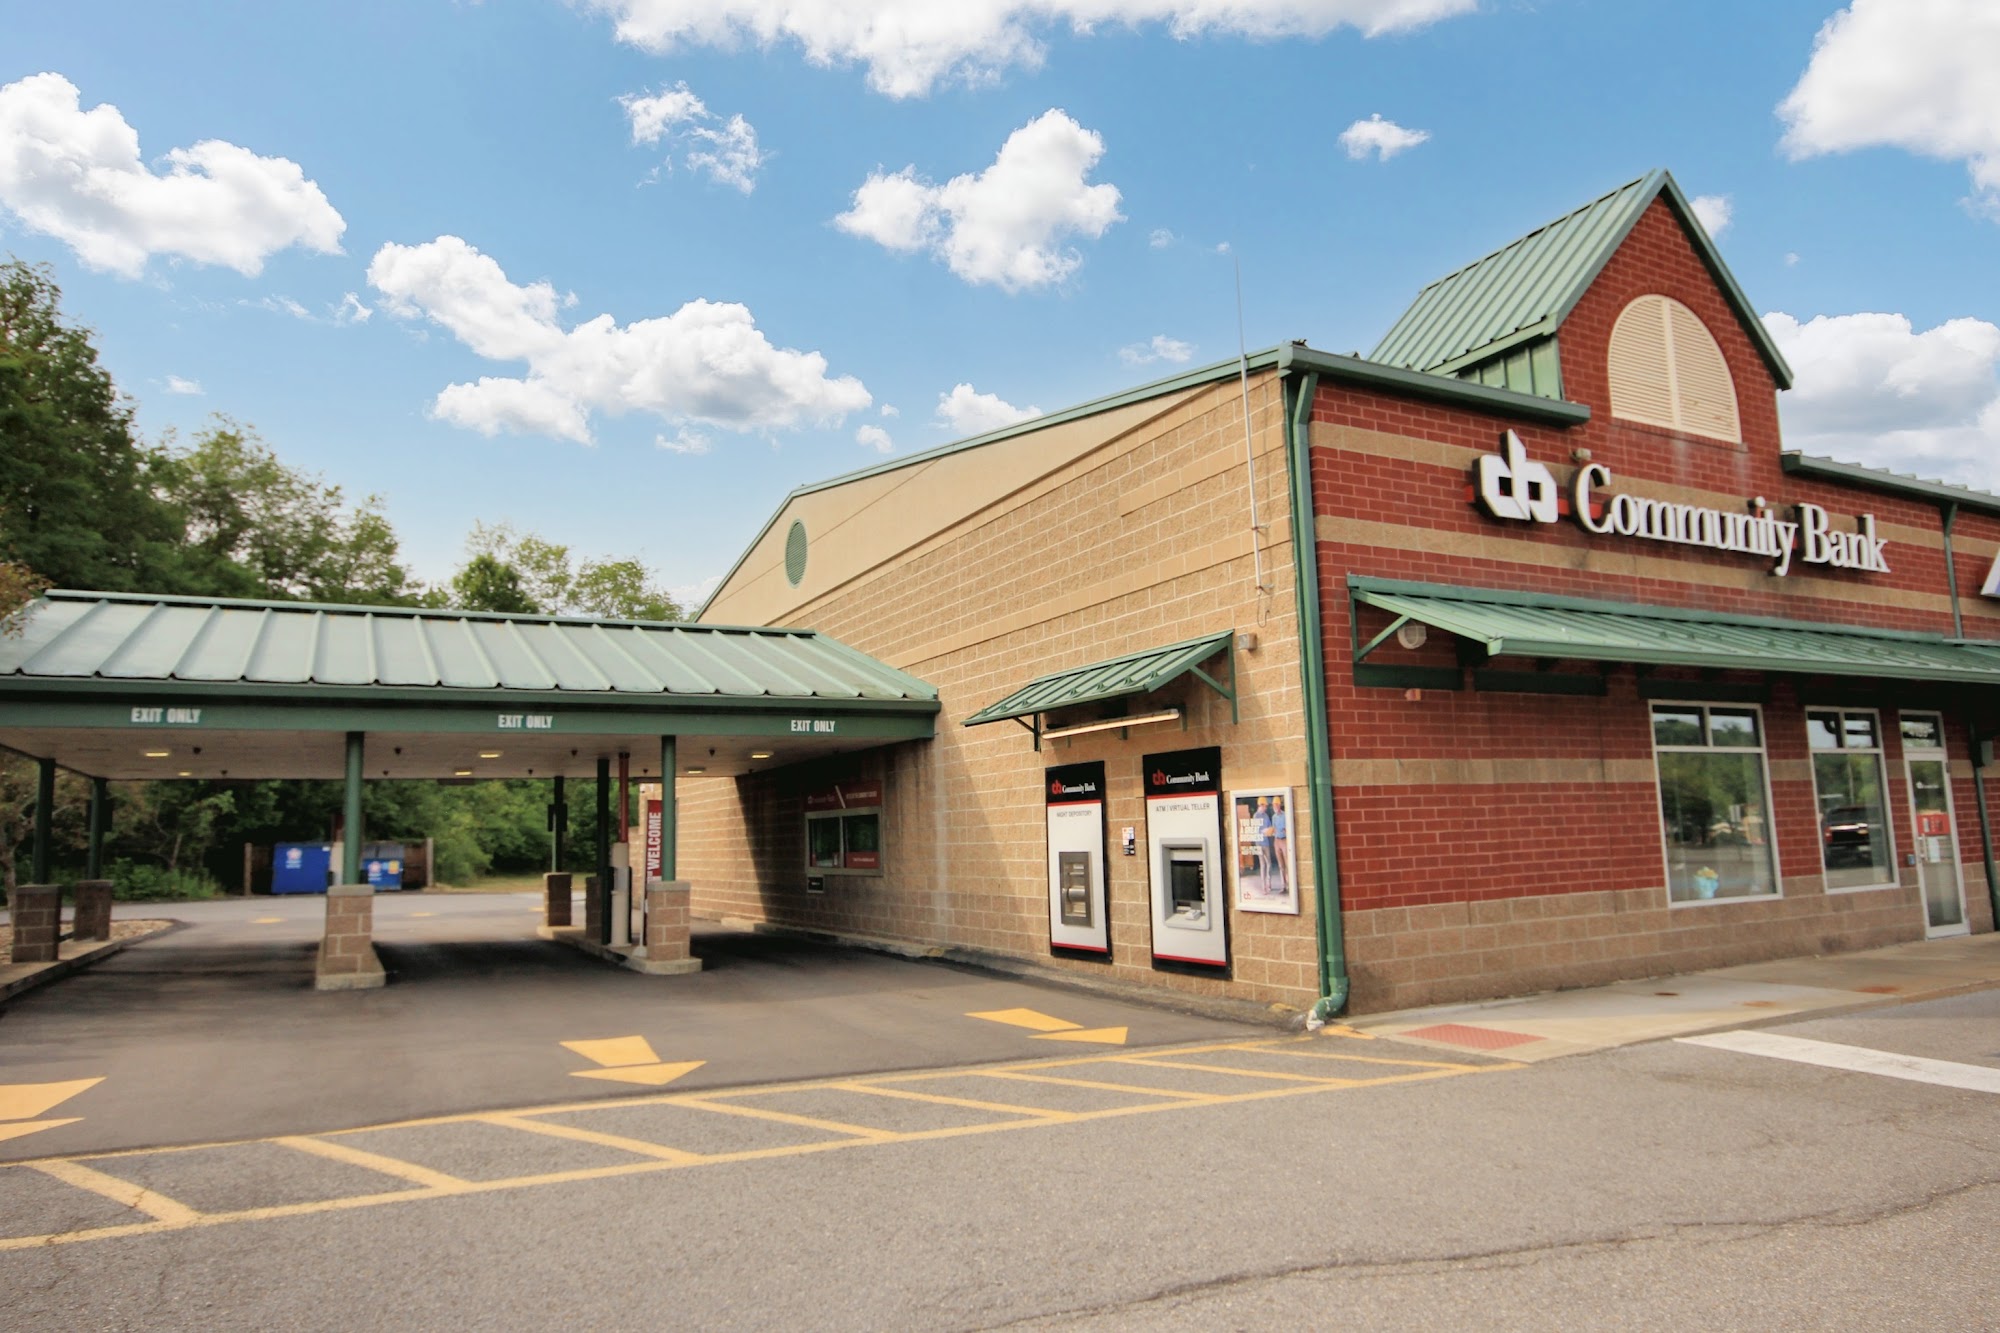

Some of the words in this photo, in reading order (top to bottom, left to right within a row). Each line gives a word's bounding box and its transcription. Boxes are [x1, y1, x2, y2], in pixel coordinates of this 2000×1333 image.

[1571, 463, 1799, 577] Community
[1799, 503, 1891, 573] Bank
[131, 707, 163, 723] EXIT
[166, 708, 202, 724] ONLY
[498, 714, 524, 728] EXIT
[525, 715, 553, 729] ONLY
[790, 719, 811, 732] EXIT
[813, 720, 836, 733] ONLY
[1166, 773, 1195, 785] Community
[1195, 771, 1210, 782] Bank
[1062, 783, 1085, 794] Community
[1084, 782, 1096, 792] Bank
[1169, 804, 1190, 812] VIRTUAL
[1191, 803, 1210, 811] TELLER
[647, 812, 662, 870] WELCOME
